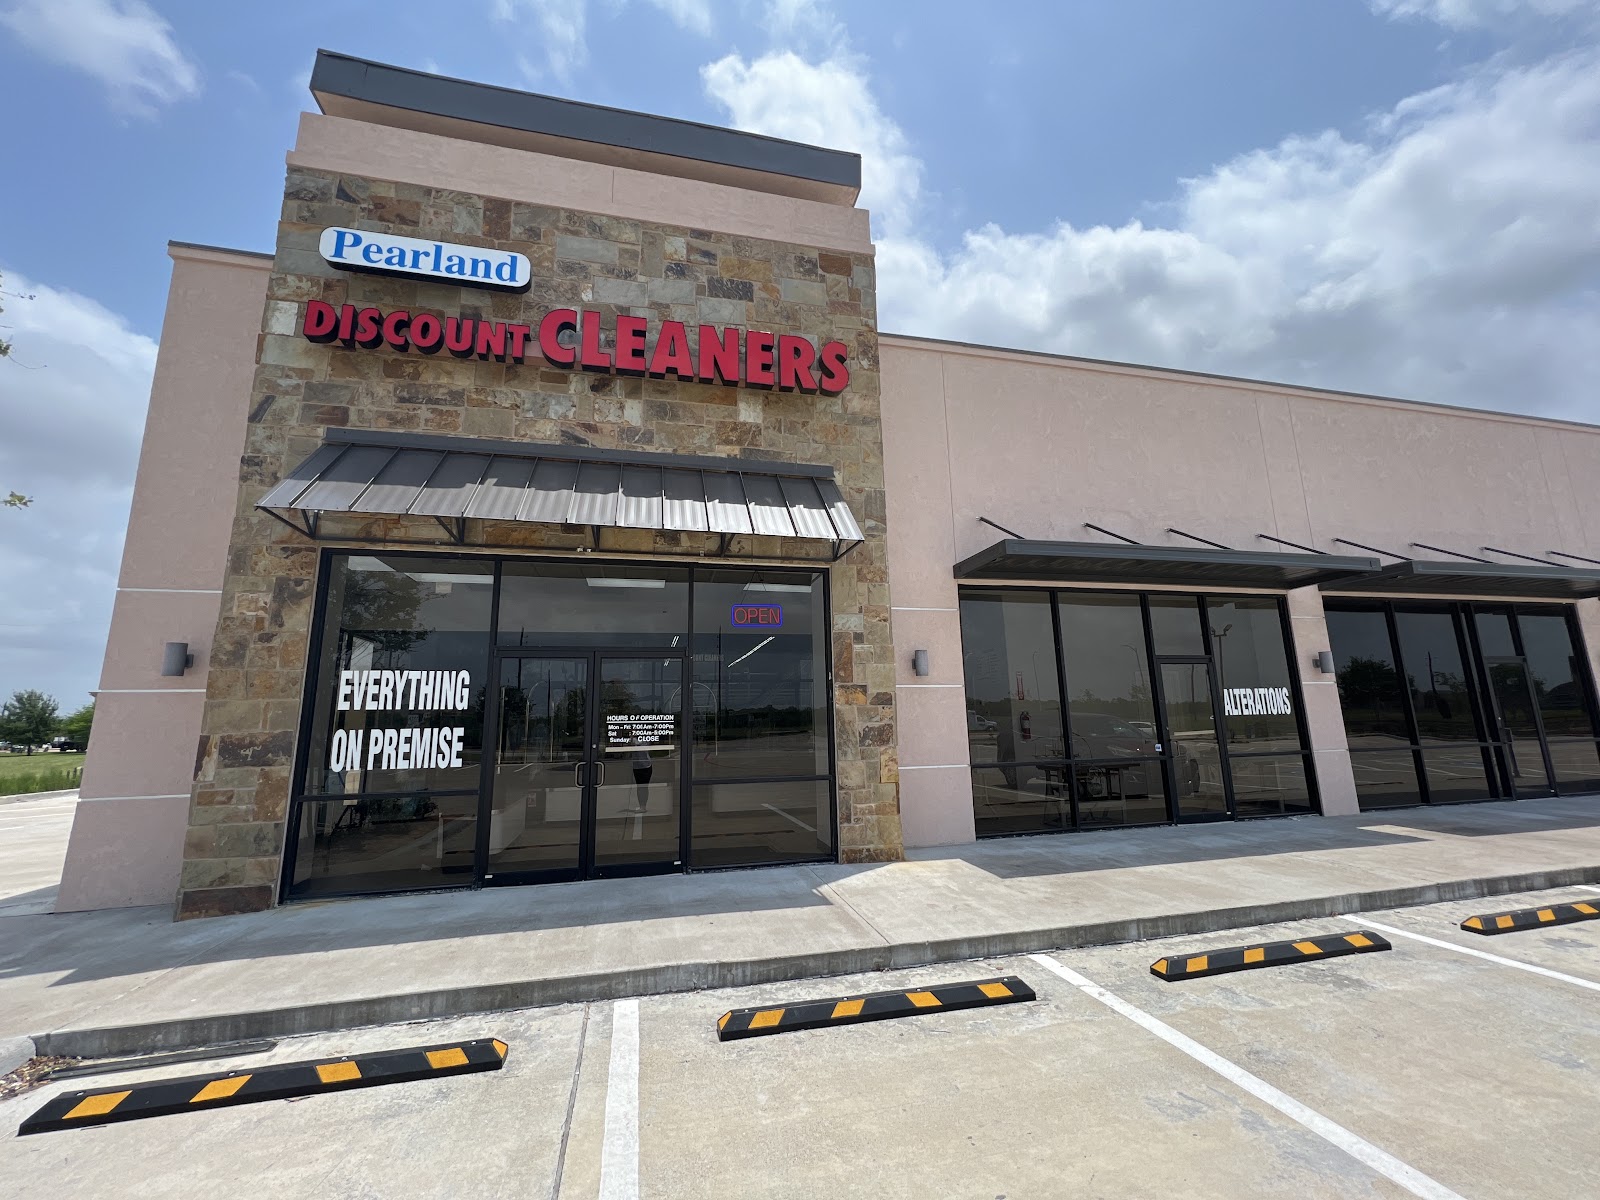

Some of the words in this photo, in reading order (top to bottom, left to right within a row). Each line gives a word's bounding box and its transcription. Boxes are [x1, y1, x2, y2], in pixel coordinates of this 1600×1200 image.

[329, 229, 519, 283] Pearland
[303, 300, 530, 360] DISCOUNT
[538, 308, 849, 393] CLEANERS
[734, 607, 780, 624] OPEN
[337, 669, 470, 711] EVERYTHING
[1223, 687, 1291, 715] ALTERATIONS
[330, 728, 363, 772] ON
[367, 726, 464, 770] PREMISE
